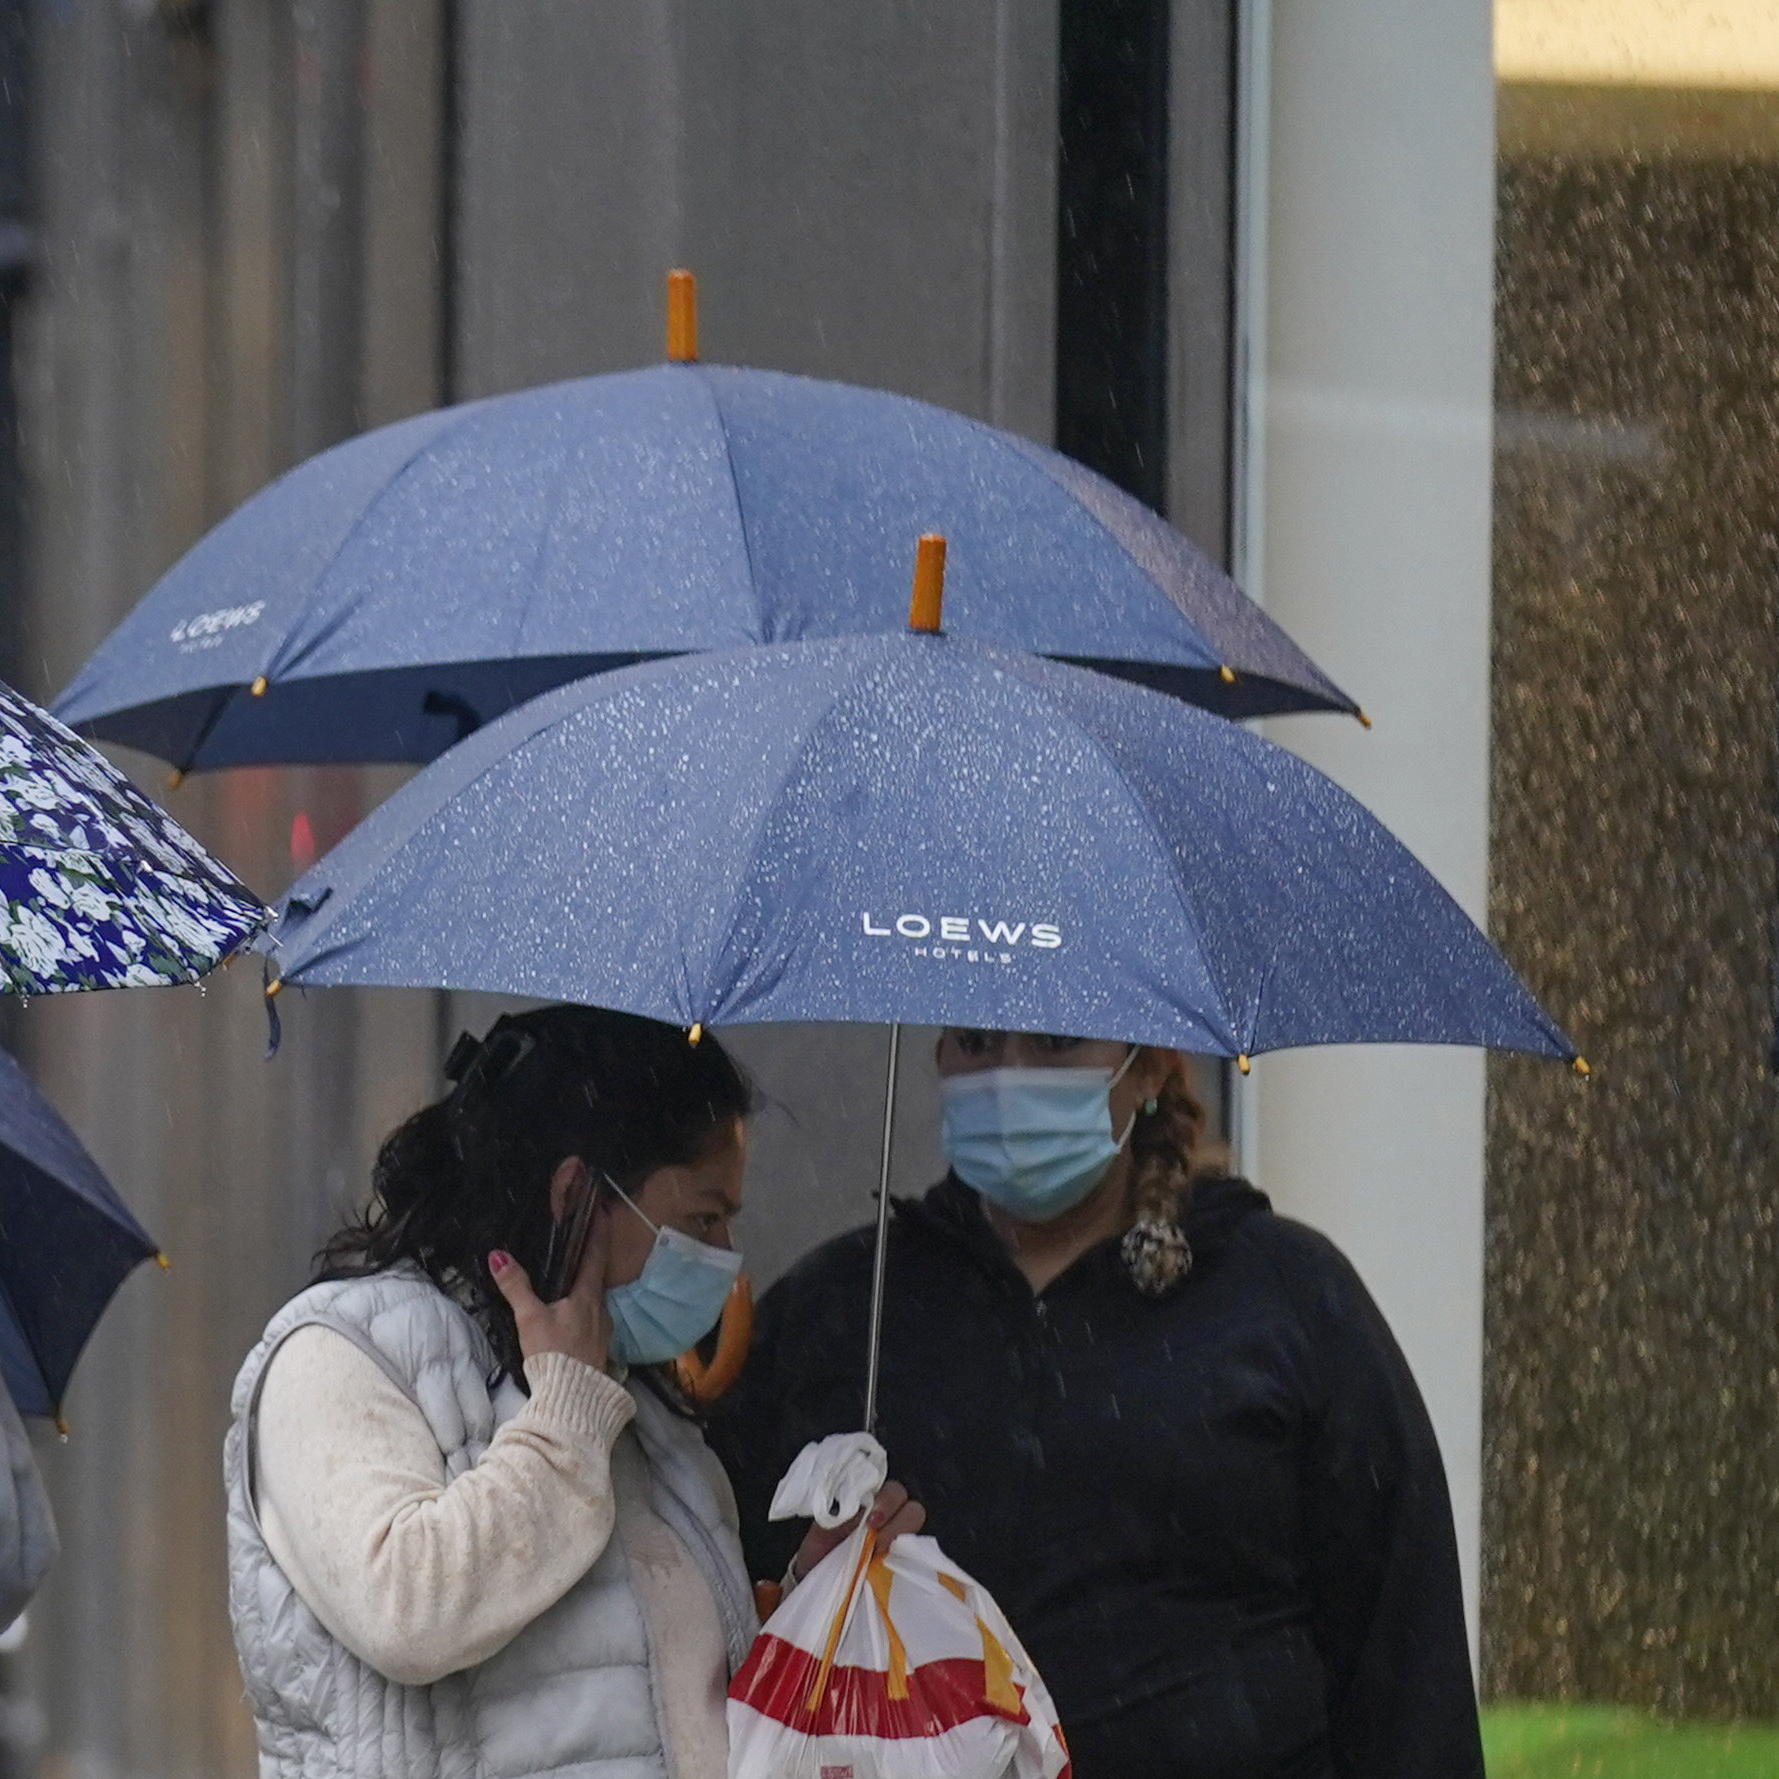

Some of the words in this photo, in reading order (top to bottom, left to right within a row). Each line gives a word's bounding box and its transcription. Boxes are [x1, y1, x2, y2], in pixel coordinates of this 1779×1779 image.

[169, 599, 266, 643] LOEWS
[863, 911, 1063, 949] LOEWS
[914, 946, 1012, 964] HOTELS
